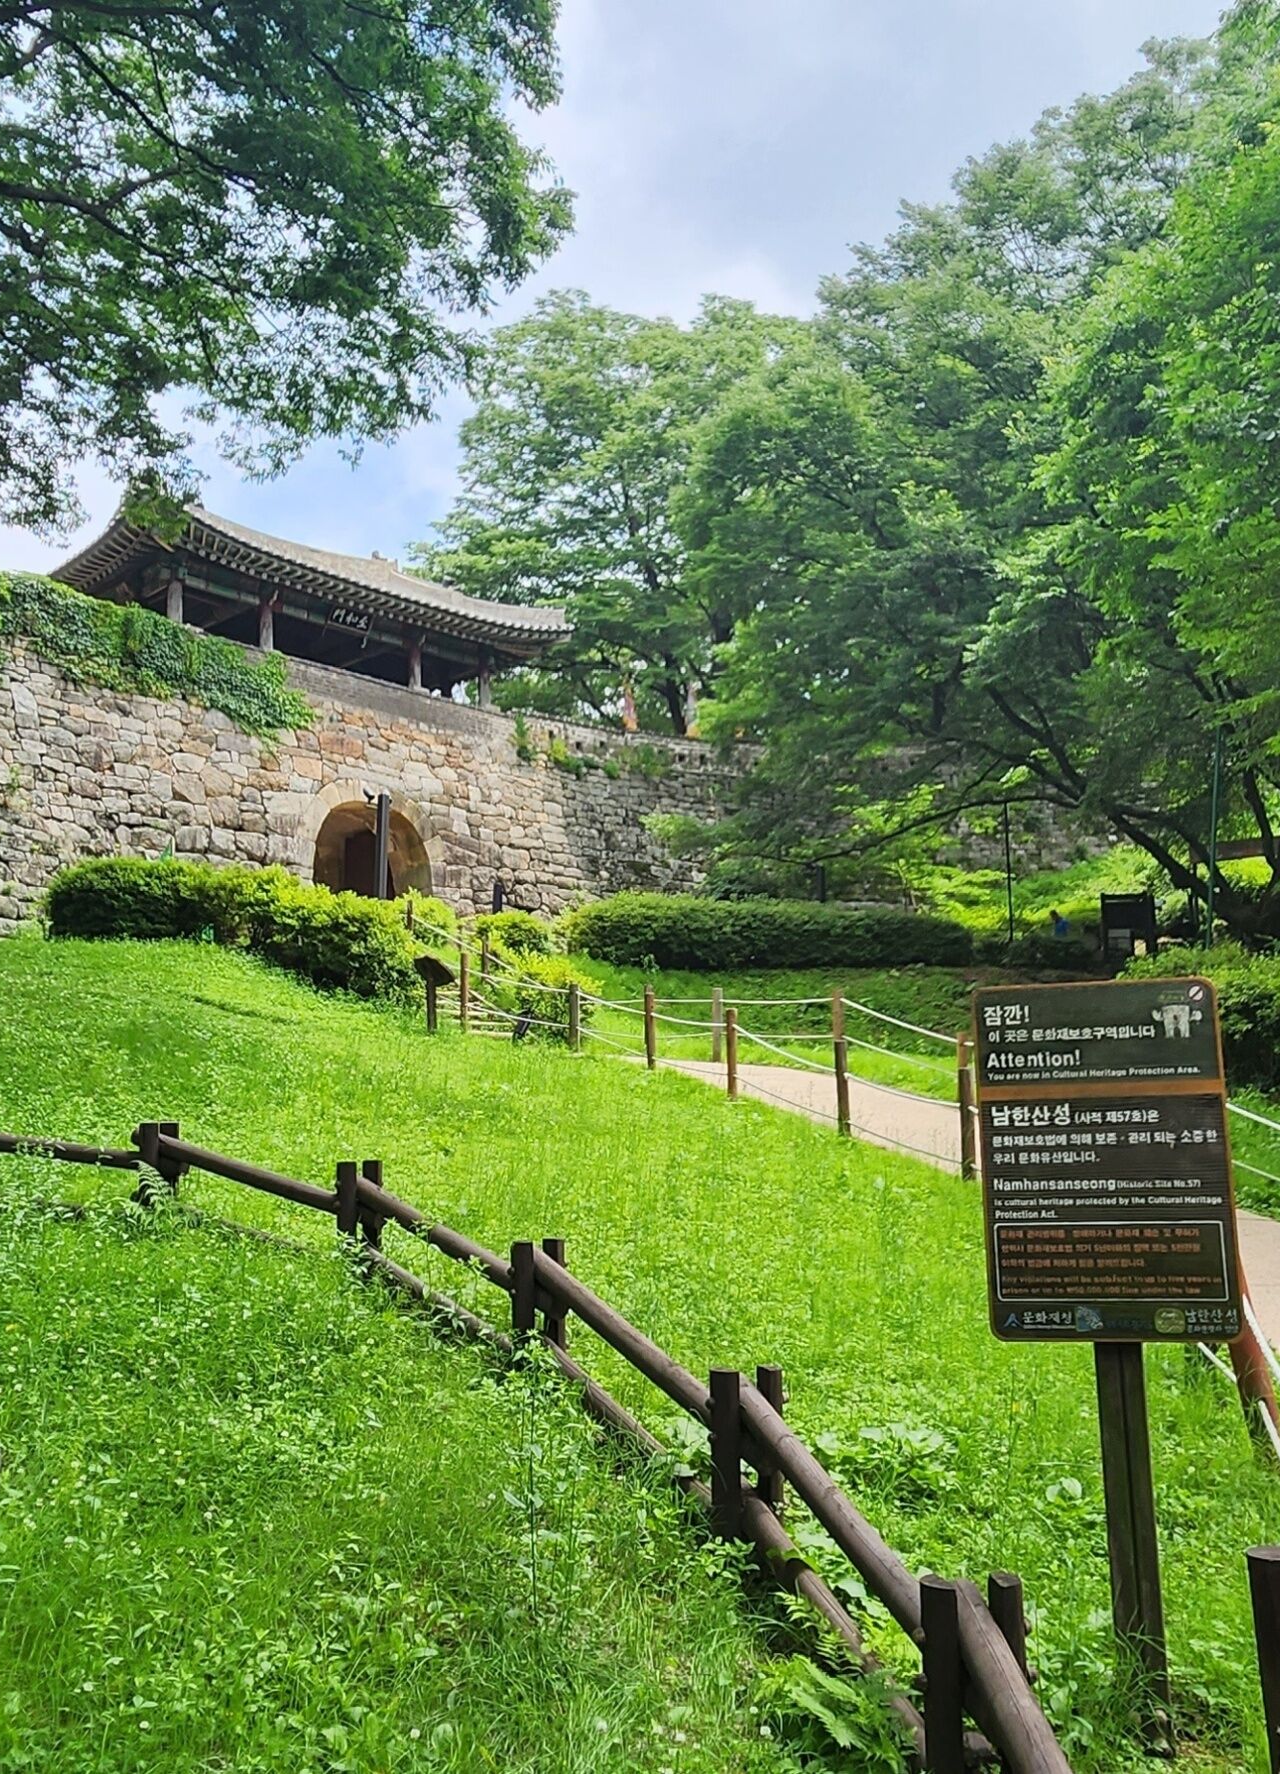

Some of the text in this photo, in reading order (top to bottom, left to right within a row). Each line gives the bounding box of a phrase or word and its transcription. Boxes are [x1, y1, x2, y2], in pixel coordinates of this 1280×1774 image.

[983, 1004, 1030, 1026] 잠깐!
[988, 1025, 1155, 1043] 이 곳은 문화재보호구역입니다
[987, 1049, 1081, 1069] Attention!
[988, 1073, 1004, 1081] You
[1041, 1070, 1051, 1079] in
[1052, 1069, 1088, 1079] Cultural
[1089, 1068, 1127, 1078] Heritage
[1128, 1067, 1175, 1076] Protection
[1177, 1066, 1201, 1075] Area.
[991, 1103, 1160, 1127] 남한산성 (사적 제57호)은
[992, 1134, 1068, 1147] 문화재보호법에
[1069, 1133, 1092, 1146] 의해
[1094, 1132, 1117, 1145] 보존
[1128, 1132, 1151, 1144] 관리
[1153, 1132, 1177, 1144] 되는
[993, 1151, 1101, 1165] 우리 문화유산입니다.
[993, 1178, 1116, 1191] Namhansanseong
[1038, 1198, 1074, 1206] heritage
[1075, 1197, 1117, 1206] protected
[1118, 1197, 1129, 1206] by
[1131, 1196, 1145, 1204] the
[1147, 1196, 1183, 1204] Cultural
[1184, 1196, 1223, 1205] Heritage
[995, 1209, 1059, 1219] Protection Act.
[1022, 1311, 1072, 1324] 문화재청
